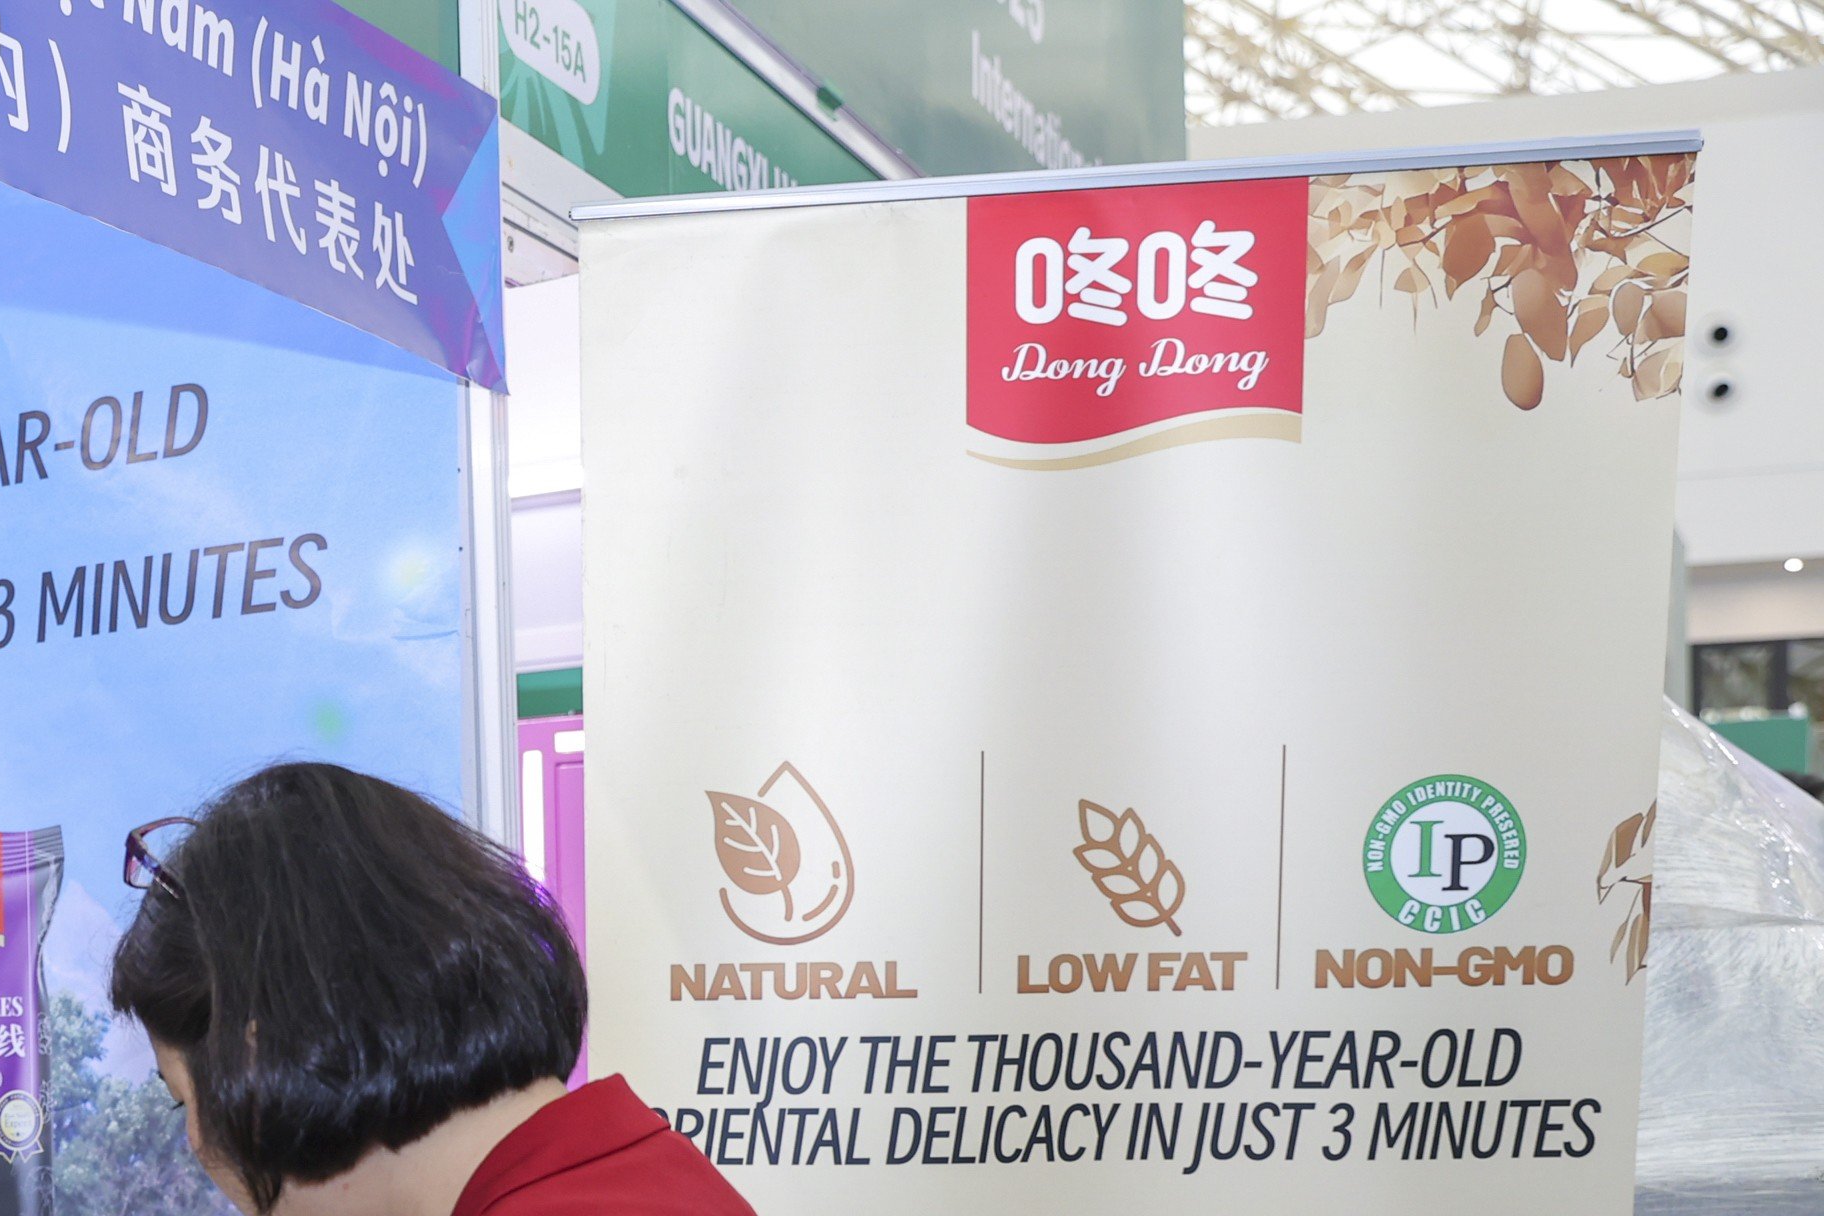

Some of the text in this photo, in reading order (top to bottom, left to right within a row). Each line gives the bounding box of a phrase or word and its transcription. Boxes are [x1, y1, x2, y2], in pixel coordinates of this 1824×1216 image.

[514, 0, 586, 83] H2-15A
[251, 15, 329, 127] (Hà
[343, 72, 427, 190] Nội)
[1014, 219, 1259, 327] 咚咚
[1001, 337, 1269, 397] Dong Dong
[36, 532, 329, 645] MINUTES
[1366, 780, 1522, 873] NON-GMO IDENTITY PRESERED
[1396, 897, 1487, 933] CCIC
[669, 960, 919, 1002] NATURAL
[1017, 951, 1249, 995] LOW FAT
[1314, 944, 1575, 990] NON-GMO
[696, 1027, 1523, 1108] ENJOY THE THOUSAND-YEAR-OLD
[885, 1102, 1122, 1166] DELICACY
[1126, 1102, 1184, 1161] IN
[1182, 1101, 1317, 1176] JUST
[1321, 1102, 1356, 1162] 3
[1367, 1097, 1603, 1162] MINUTES
